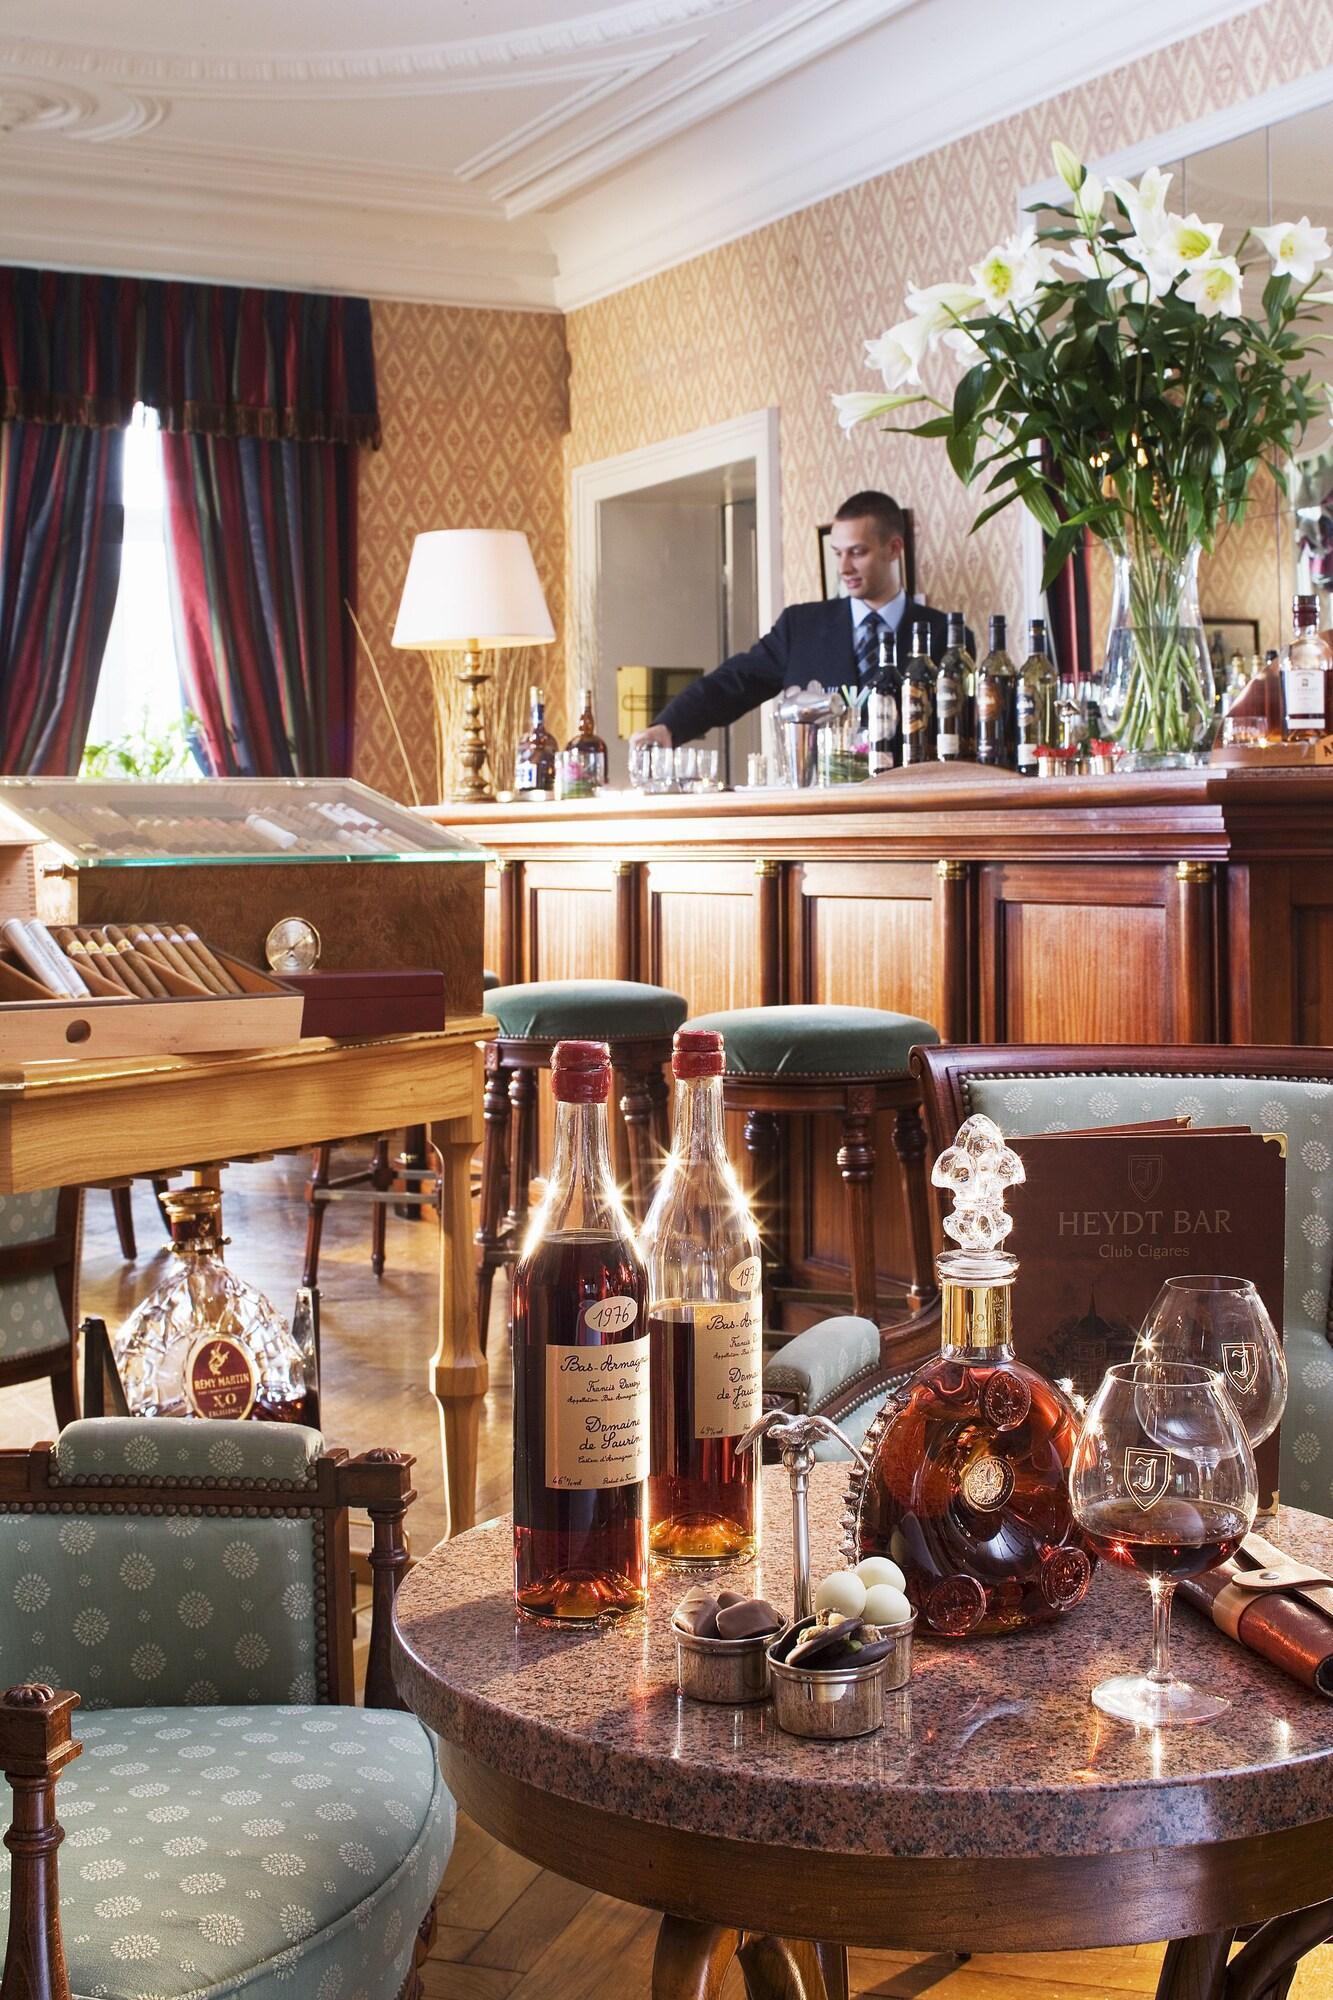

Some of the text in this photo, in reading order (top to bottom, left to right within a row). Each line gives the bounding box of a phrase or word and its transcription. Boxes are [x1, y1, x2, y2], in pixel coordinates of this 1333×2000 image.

[1057, 1209, 1233, 1236] HEYDT BAR
[1099, 1243, 1190, 1260] Club Cigares
[736, 1265, 759, 1287] 197
[592, 1302, 631, 1328] 1976
[560, 1354, 648, 1373] Bas-Armag
[218, 1372, 250, 1387] MARTIN
[586, 1378, 615, 1393] Francis
[716, 1387, 731, 1400] de
[579, 1437, 597, 1451] de
